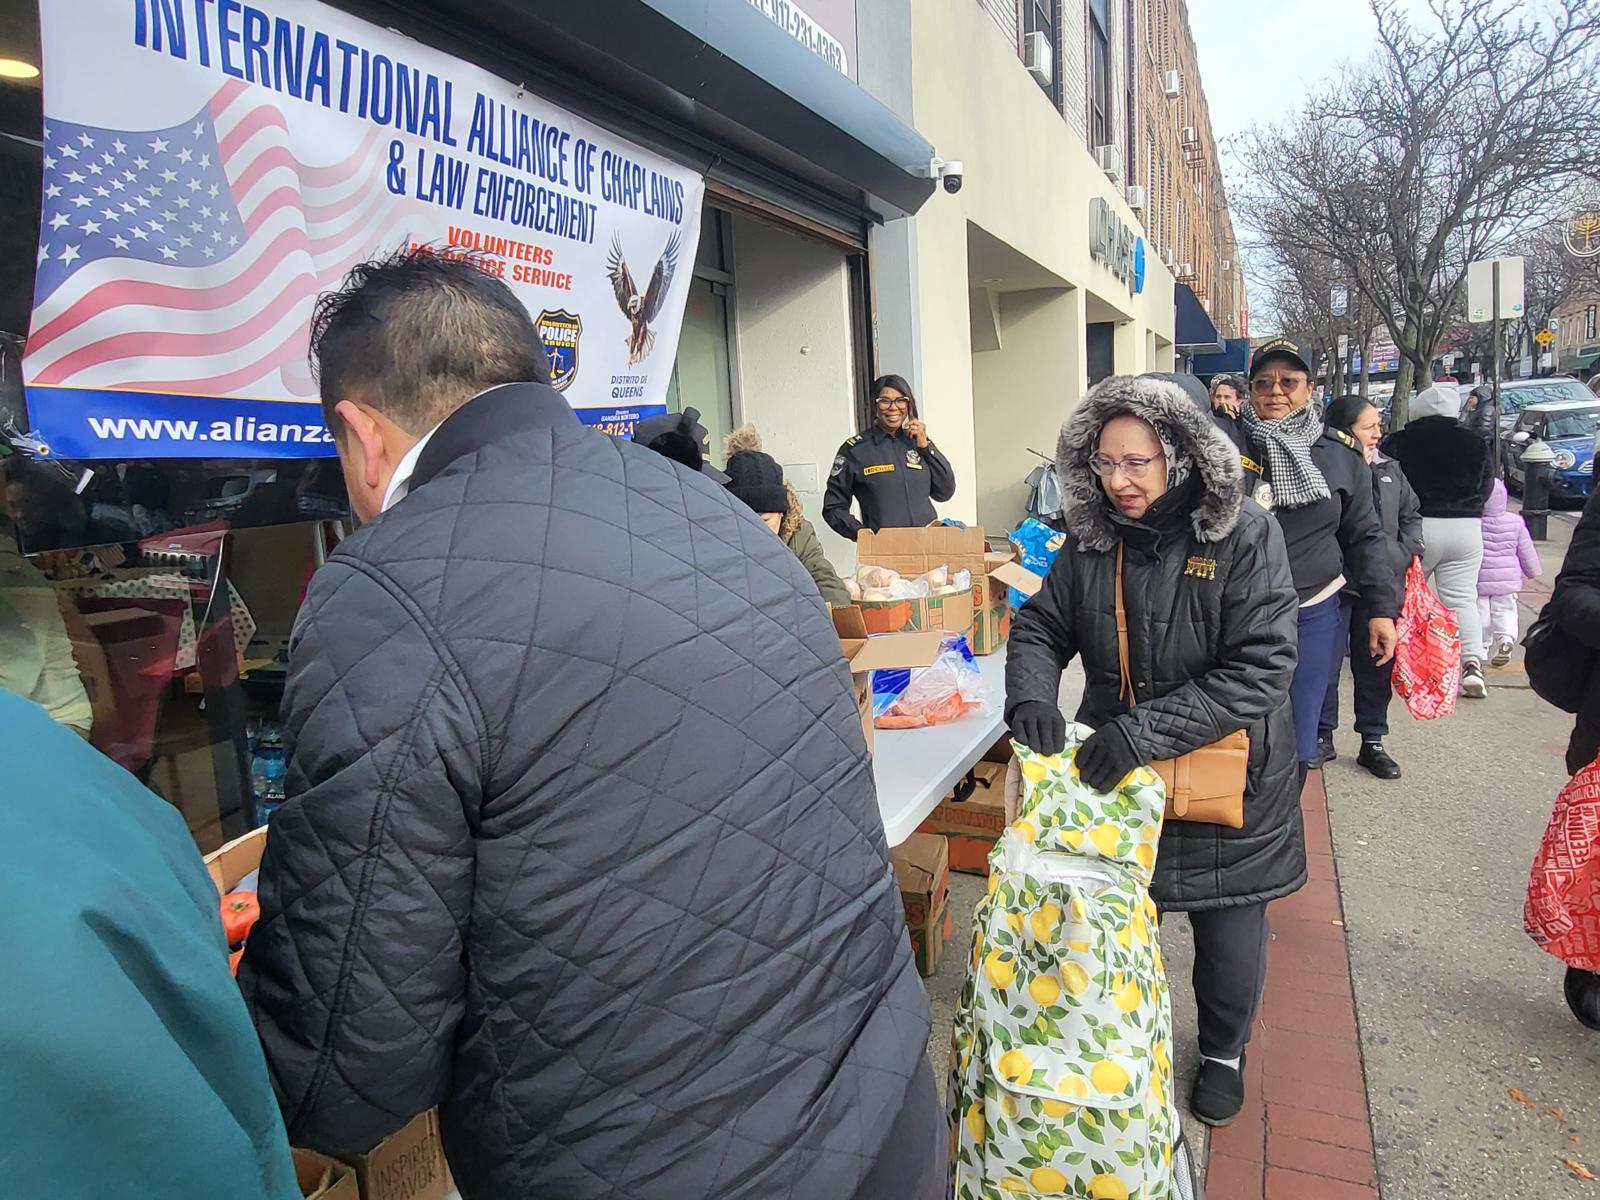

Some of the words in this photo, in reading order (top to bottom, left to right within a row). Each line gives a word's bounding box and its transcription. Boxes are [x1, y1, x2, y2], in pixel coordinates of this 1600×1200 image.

[134, 0, 457, 147] INTERNATIONAL
[467, 92, 571, 187] ALLIANCE
[574, 138, 597, 195] OF
[601, 150, 685, 226] CHAPLAINS
[386, 139, 406, 196] &
[416, 148, 470, 210] LAW
[473, 168, 598, 244] ENFORCEMENT
[448, 225, 554, 266] VOLUNTEERS
[512, 264, 573, 291] SERVICE
[540, 325, 578, 343] POLICE
[543, 339, 576, 348] ERVICE
[611, 375, 639, 384] DISTRITO
[611, 386, 644, 398] QUEENS
[1567, 806, 1590, 865] FEEDING
